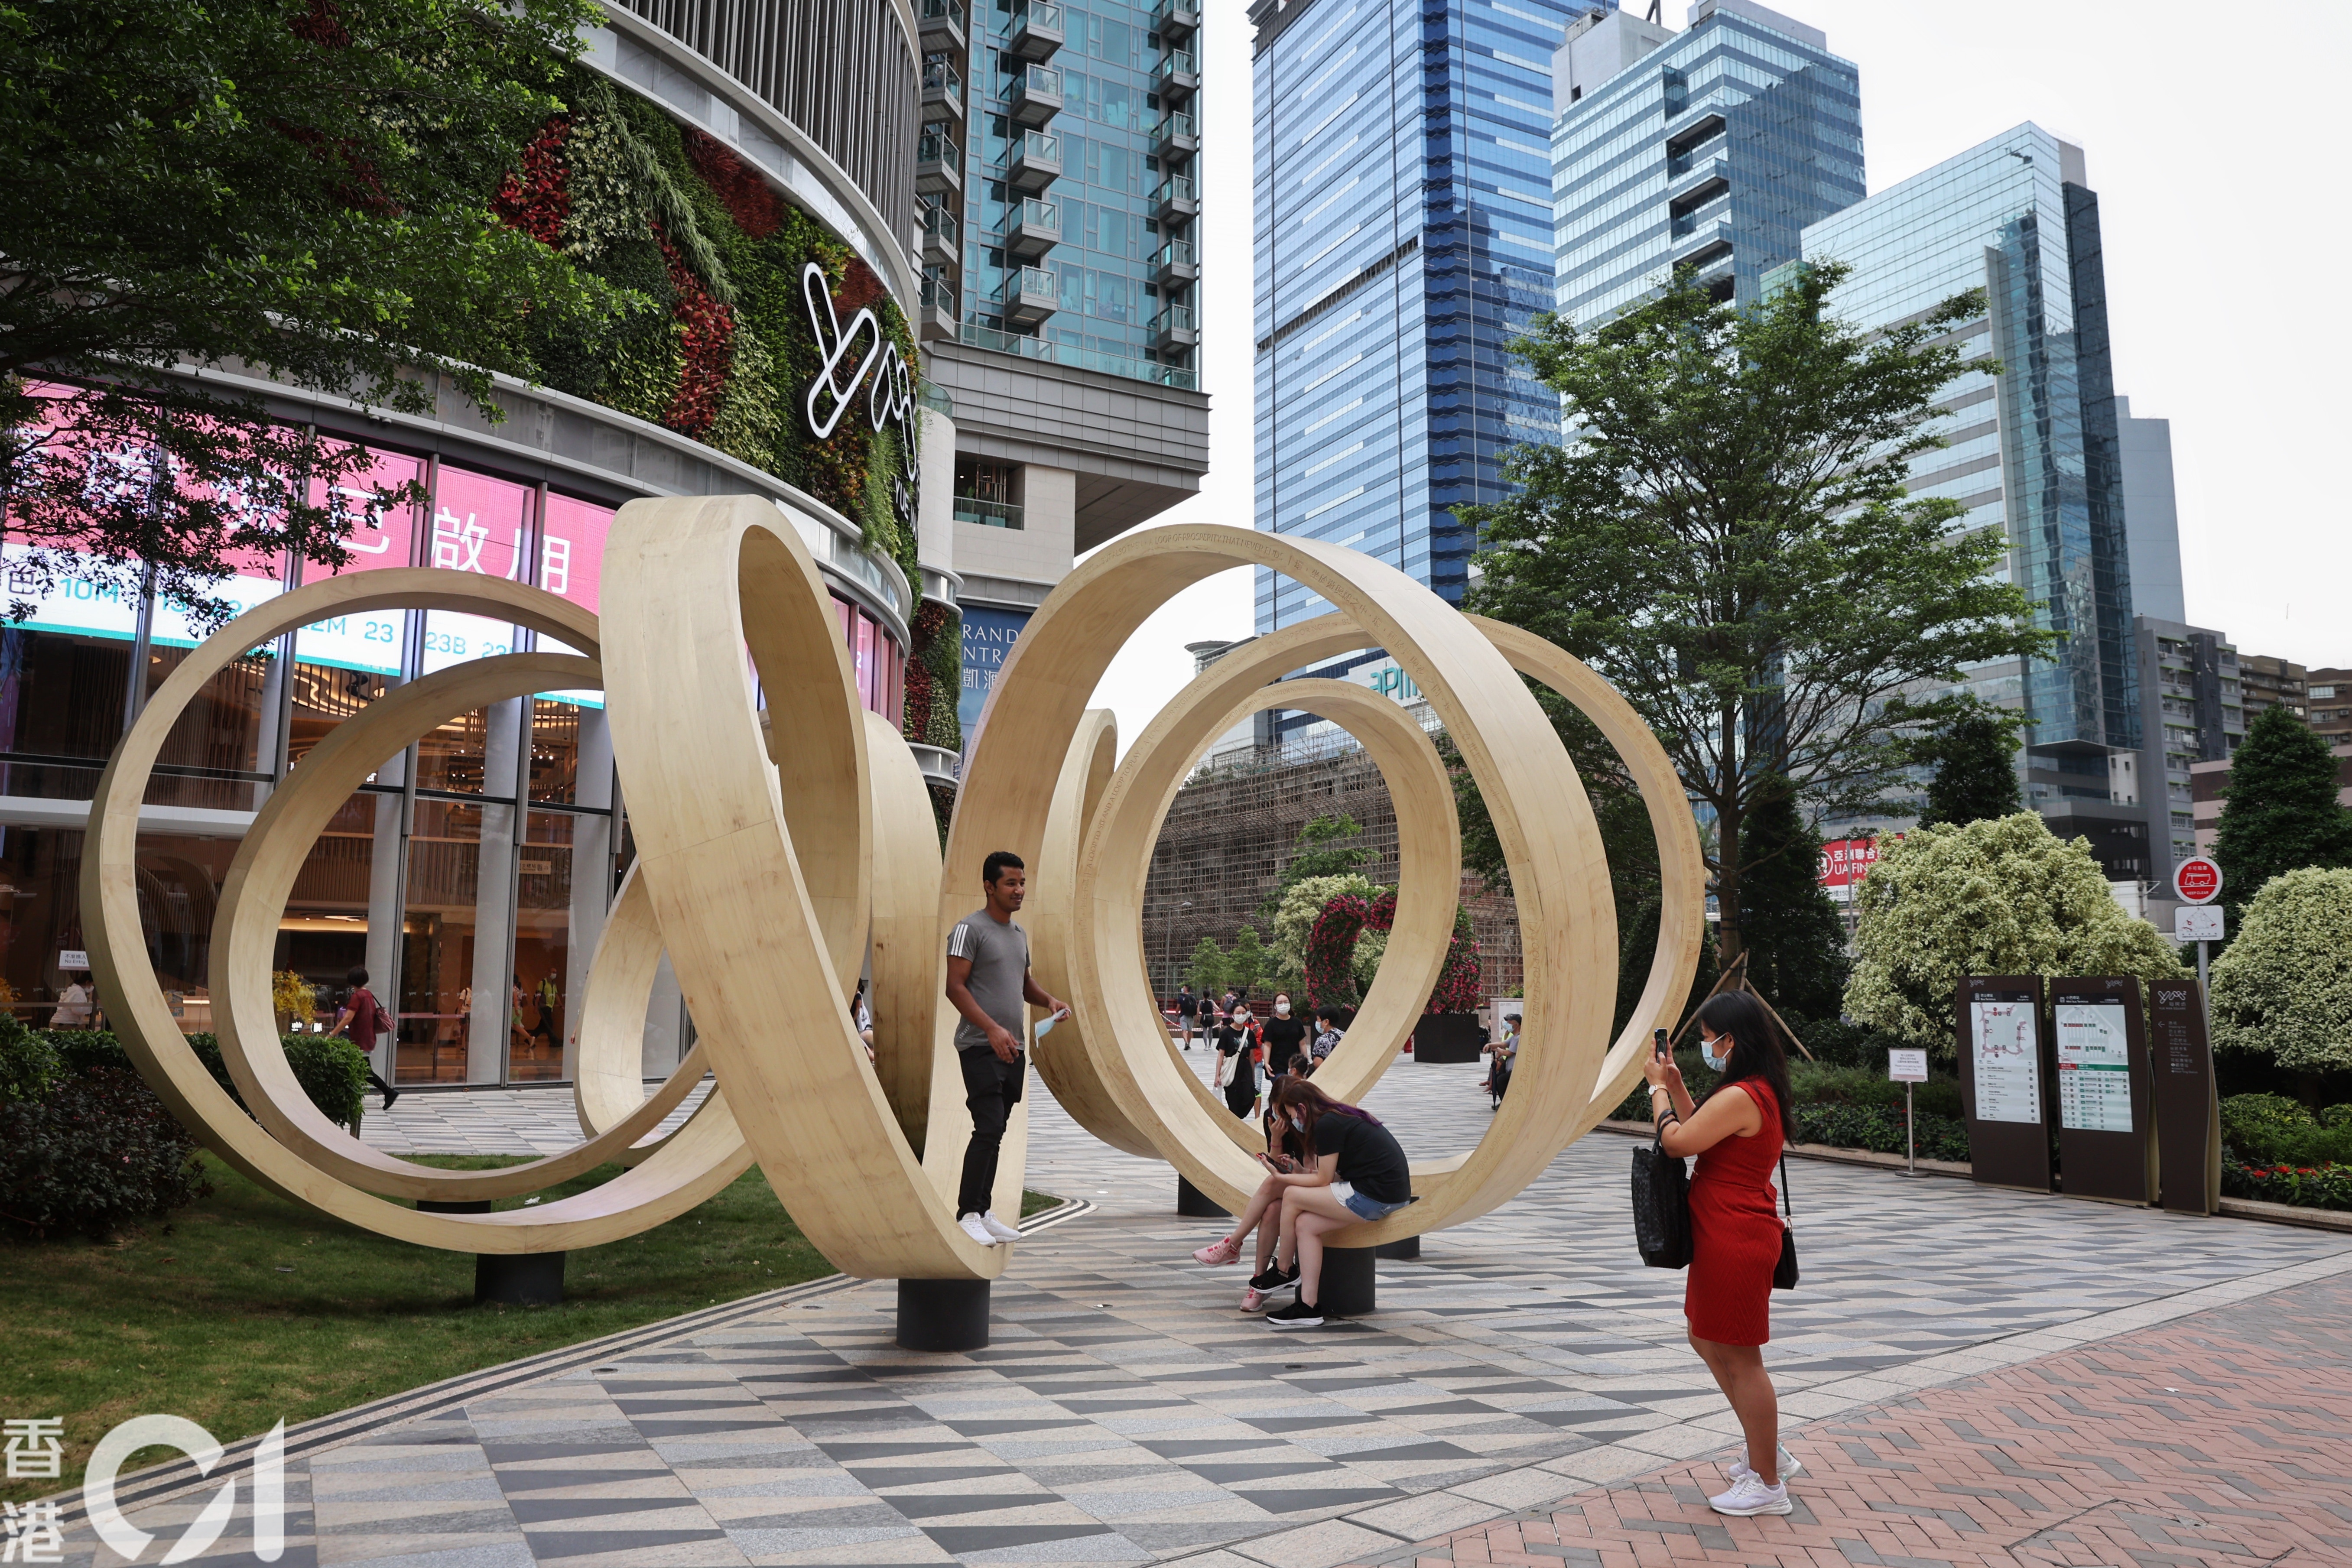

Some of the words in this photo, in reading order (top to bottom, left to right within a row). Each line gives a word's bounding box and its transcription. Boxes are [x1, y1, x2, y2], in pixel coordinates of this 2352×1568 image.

[1155, 535, 1171, 545] LOOP
[1182, 532, 1222, 542] PROSPERITY
[1222, 536, 1240, 546] THAT
[59, 578, 120, 603] 10M
[425, 631, 466, 655] 23B
[1493, 628, 1512, 640] THAT
[1512, 634, 1536, 649] NEVER
[1537, 645, 1559, 660] ENDS
[1088, 841, 1097, 862] LOOP
[1095, 831, 1101, 841] TO
[1098, 818, 1106, 830] SIT
[1103, 802, 1112, 819] AND
[1111, 777, 1124, 796] LOOP
[1122, 766, 1131, 777] TO
[1129, 750, 1141, 767] PLAY
[1147, 721, 1163, 740] LOOP
[1162, 710, 1175, 722] FOR
[1173, 691, 1194, 711] NIGHT
[1193, 680, 1207, 694] AND
[1212, 663, 1231, 678] LOOP
[1231, 655, 1246, 666] FOR
[1274, 632, 1294, 645] LOOP
[1295, 627, 1311, 636] FOR
[1311, 621, 1331, 631] NOW
[1531, 936, 1540, 964] LOOP
[1533, 965, 1541, 979] TO
[1533, 979, 1541, 995] SIT
[1528, 1023, 1538, 1050] LOOP
[1526, 1051, 1533, 1063] TO
[1520, 1063, 1530, 1084] PLAY
[1487, 1132, 1503, 1158] NIGHT
[1477, 1153, 1489, 1171] AND
